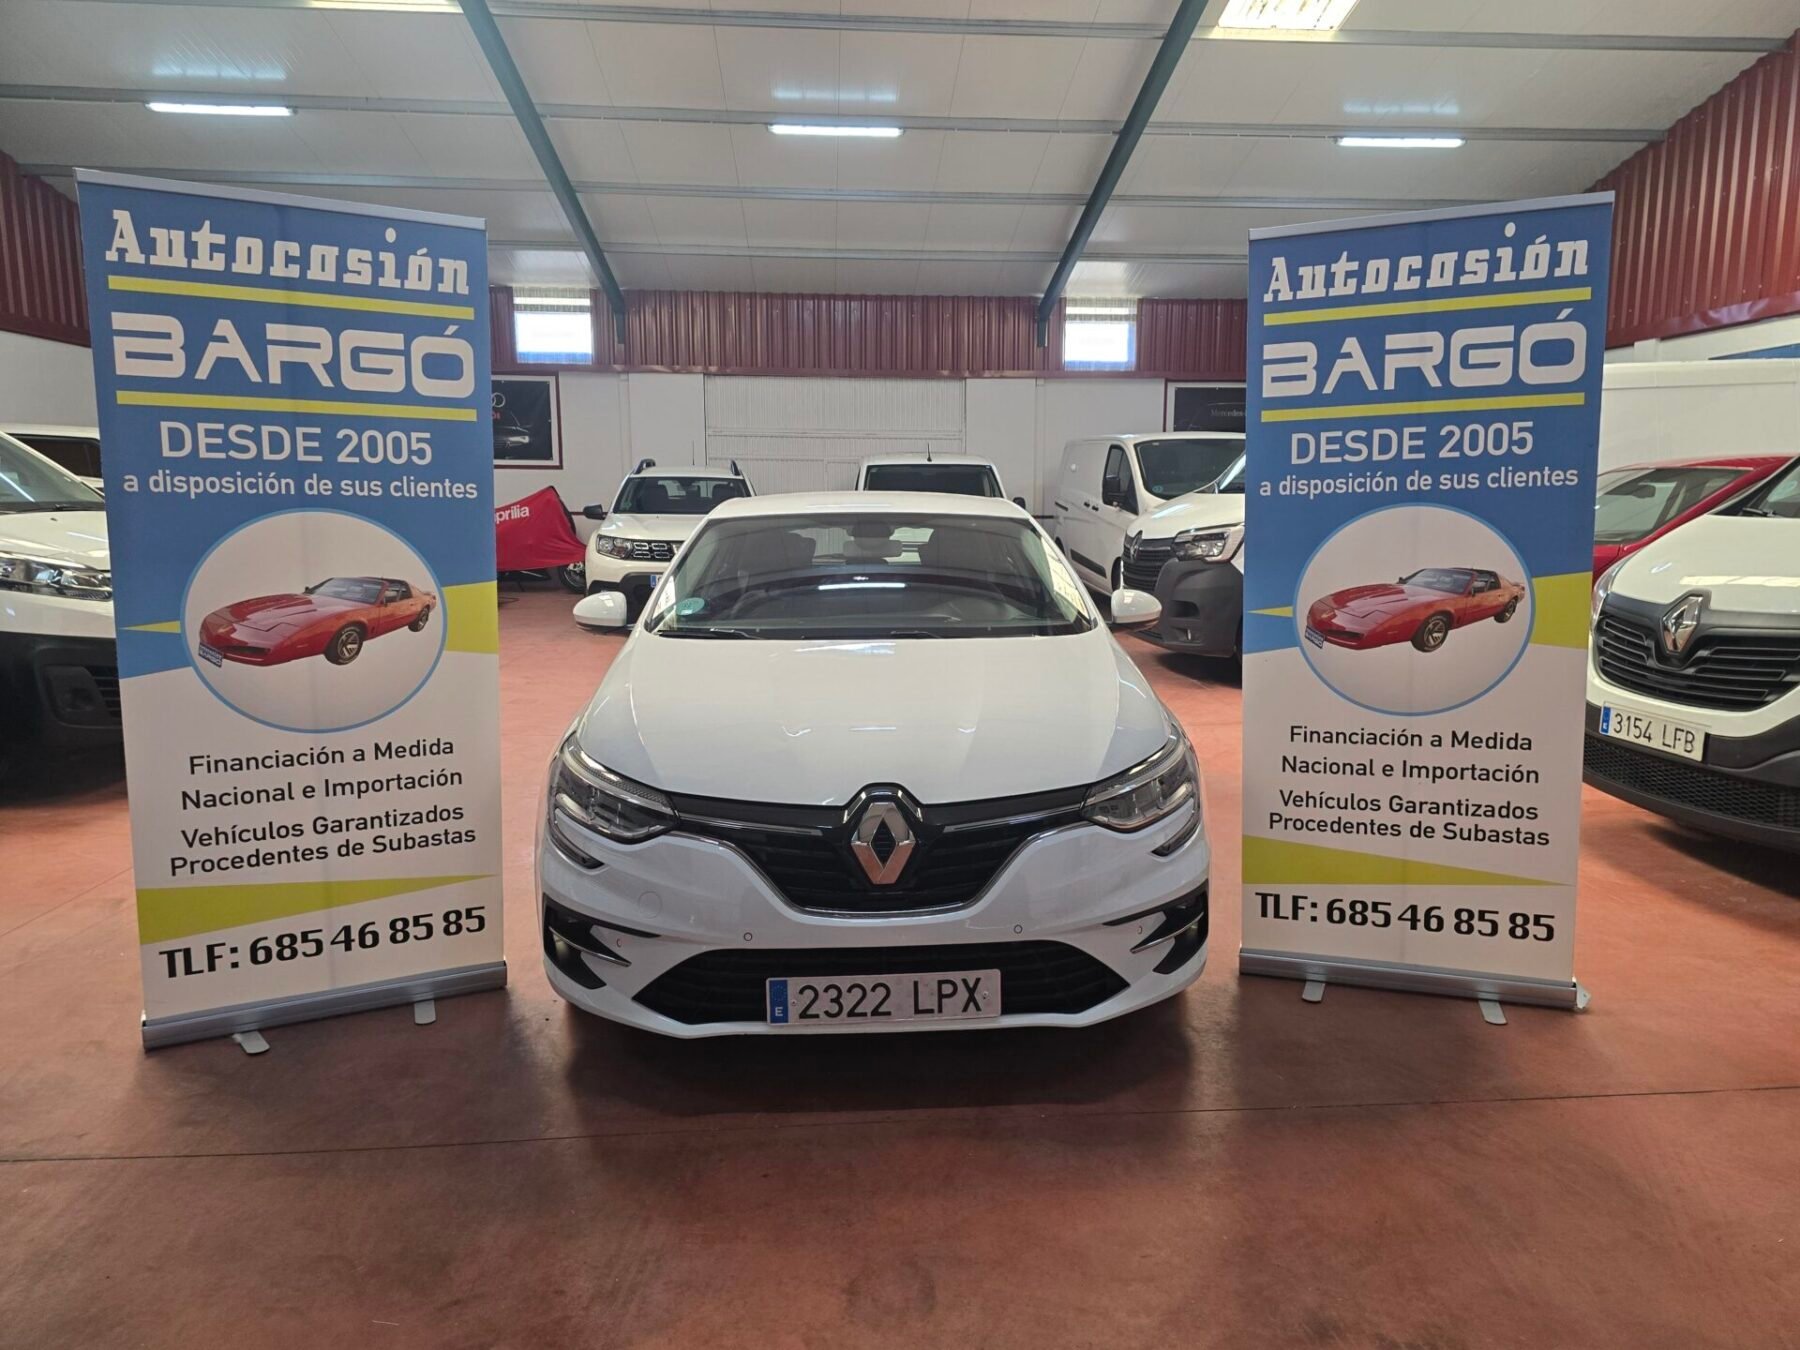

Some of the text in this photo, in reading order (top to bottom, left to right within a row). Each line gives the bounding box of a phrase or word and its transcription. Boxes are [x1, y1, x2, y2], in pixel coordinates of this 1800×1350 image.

[106, 210, 469, 295] Autocasión
[1264, 222, 1588, 302] Autocasión
[111, 312, 475, 398] BARGÓ
[1262, 308, 1586, 398] BARGÓ
[160, 421, 432, 465] DESDE 2005
[1292, 422, 1533, 464] DESDE 2005
[124, 470, 477, 499] a disposición de sus clientes
[1260, 466, 1578, 499] a disposición de sus clientes
[495, 504, 530, 525] prilia
[1291, 726, 1531, 750] Financiación a Medida
[1613, 712, 1696, 754] 3154 LFB
[190, 738, 453, 775] Financiación a Medida
[1283, 756, 1538, 783] Nacional e Importación
[182, 769, 462, 810] Nacional e Importación
[1280, 790, 1538, 820] Vehículos Garantizados
[181, 805, 463, 848] Vehículos Garantizados
[1270, 812, 1549, 845] Procedentes de Subastas
[171, 829, 475, 876] Procedentes de Subastas
[1255, 892, 1554, 941] TLF: 685 46 85 85
[159, 906, 485, 978] TLF: 685 46 85 85
[798, 977, 983, 1019] 2322 LPX
